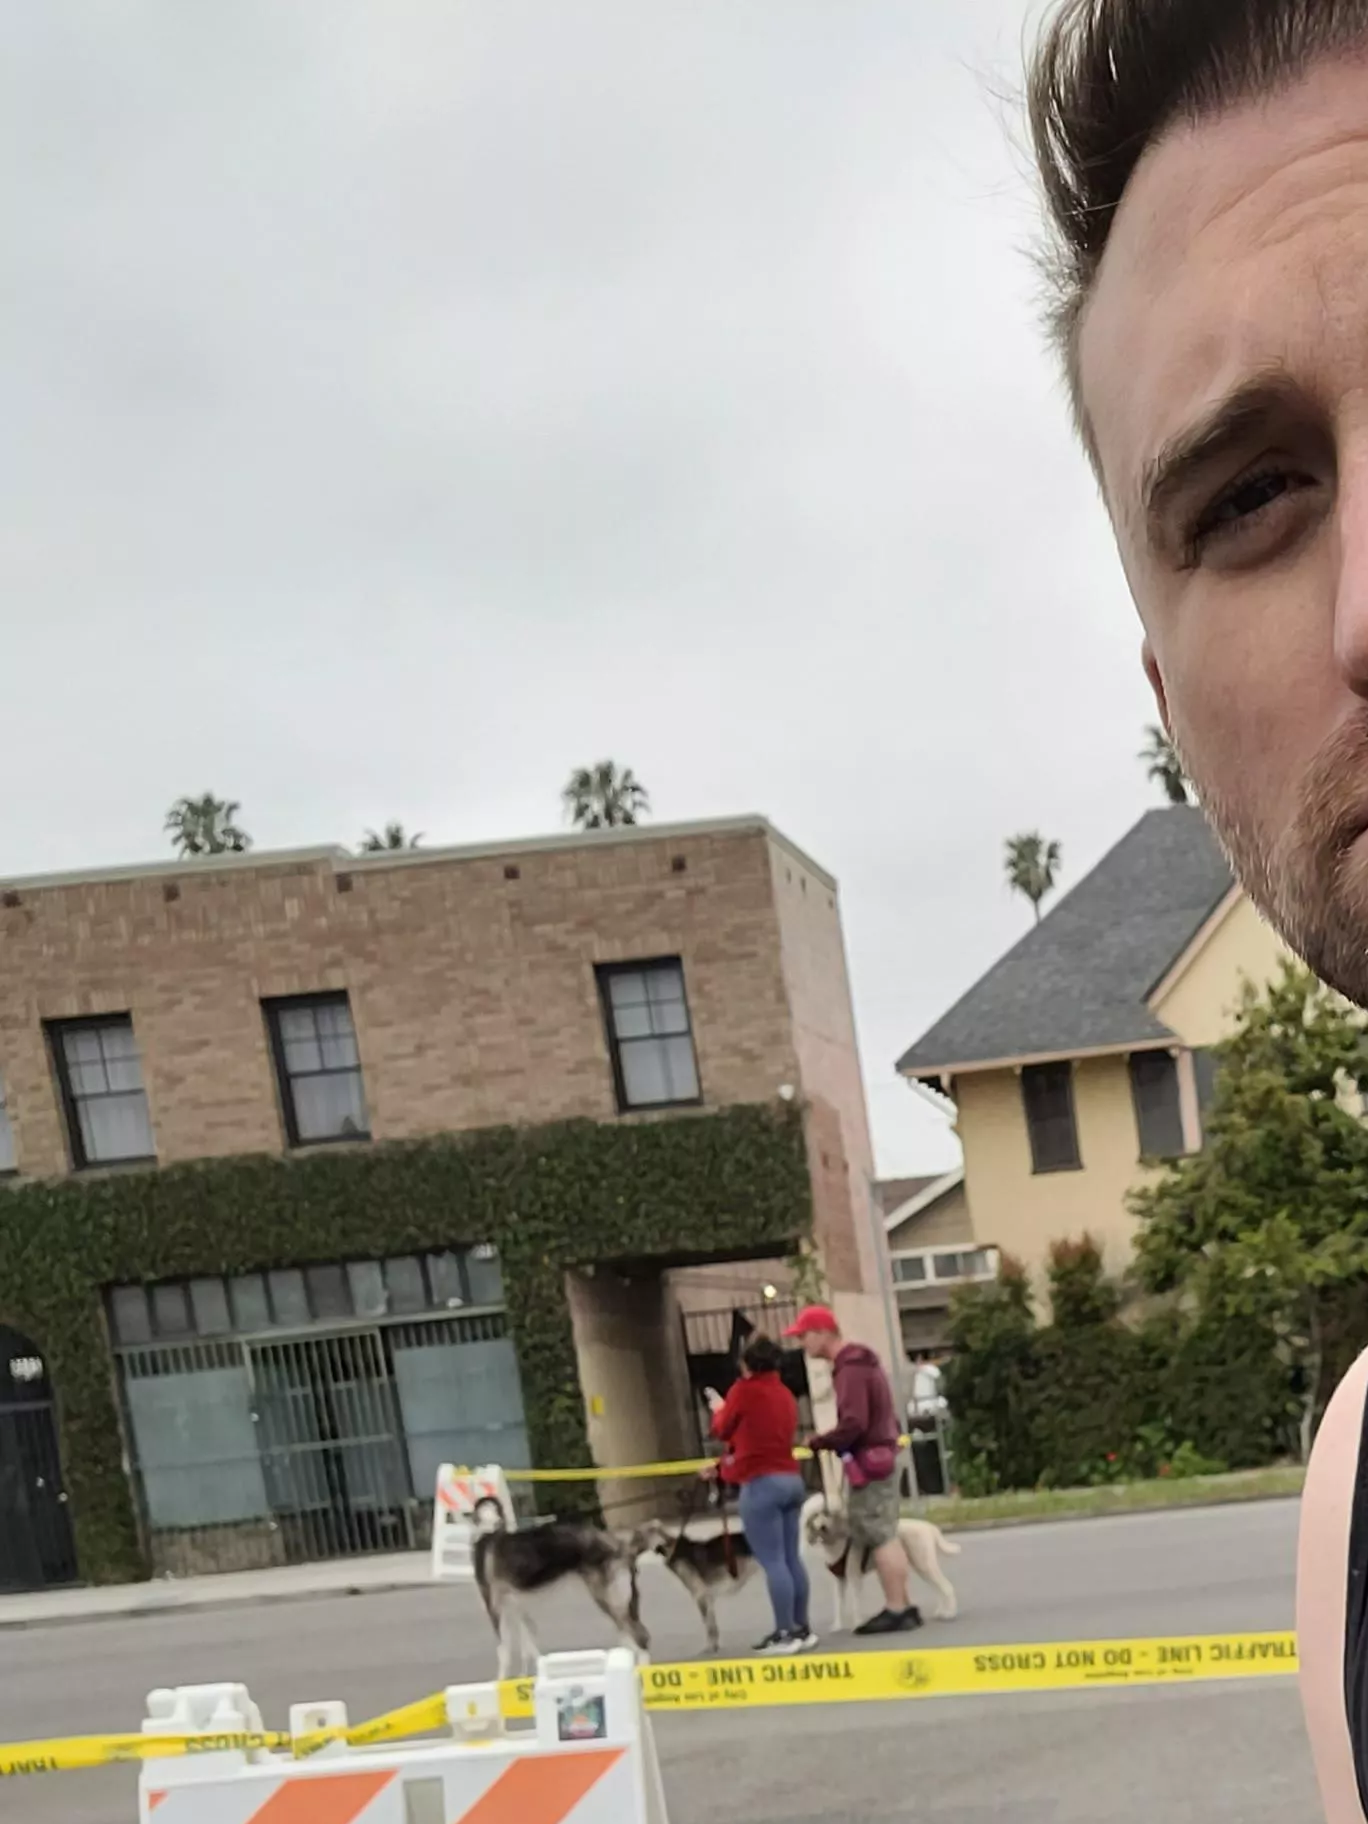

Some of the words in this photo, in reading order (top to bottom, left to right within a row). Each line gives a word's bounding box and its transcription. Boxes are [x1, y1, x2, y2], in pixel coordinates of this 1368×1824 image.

[1054, 1650, 1095, 1669] NOT
[1103, 1647, 1133, 1666] DO
[1157, 1644, 1202, 1663] LINE
[1210, 1640, 1297, 1661] TRAFFIC
[762, 1660, 854, 1683] TRAFFIC
[973, 1652, 1047, 1673] CROSS
[651, 1669, 682, 1688] DO
[707, 1666, 754, 1686] LINE
